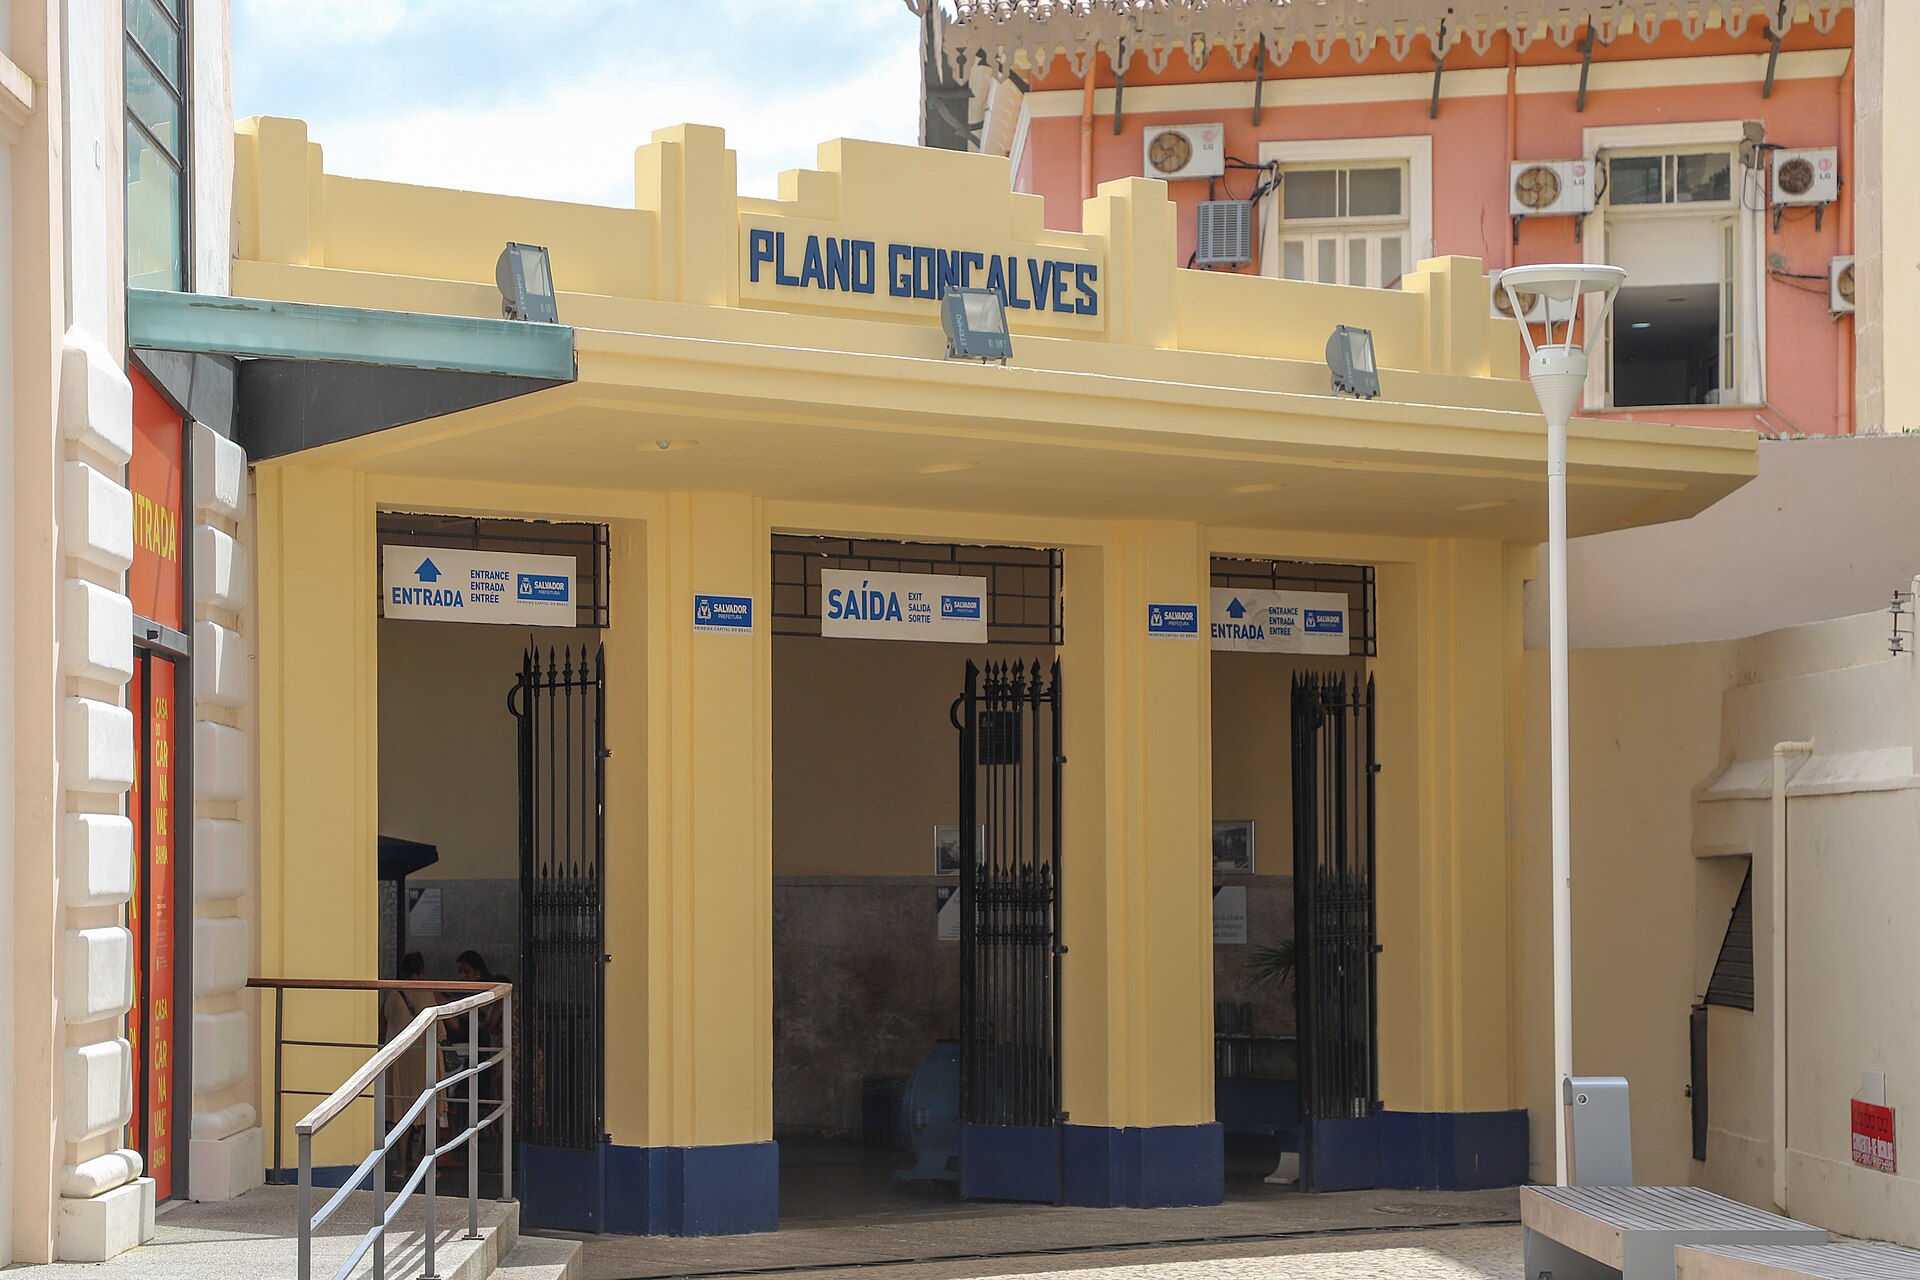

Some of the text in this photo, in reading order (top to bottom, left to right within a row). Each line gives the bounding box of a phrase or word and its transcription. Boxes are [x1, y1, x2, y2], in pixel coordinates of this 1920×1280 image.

[750, 229, 875, 295] PLANO
[131, 490, 177, 563] NTRADA
[470, 569, 510, 581] ENTRANCE
[470, 581, 505, 592] ENTRADA
[534, 580, 565, 591] SALVADOR
[392, 586, 464, 608] ENTRADA
[470, 591, 500, 604] ENTRÉE
[827, 580, 903, 622] SAÍDA
[908, 592, 923, 601] EXIT
[713, 603, 748, 615] SALVADOR
[908, 603, 931, 613] SALIDA
[953, 600, 977, 609] SALVADOR
[1268, 606, 1298, 616] ENTRANCE
[908, 614, 931, 624] SORTIE
[1164, 611, 1194, 621] SALVADOR
[1269, 616, 1296, 626] ENTRADA
[1316, 614, 1340, 624] SALVADOR
[1210, 622, 1265, 640] ENTRADA
[155, 697, 168, 720] CASA
[155, 739, 168, 768] CAR
[159, 774, 168, 802] NA
[155, 845, 168, 865] BAHIA
[155, 998, 168, 1022] CASA
[154, 1040, 168, 1071] CAR
[158, 1074, 167, 1104] NA
[153, 1149, 166, 1169] BAHIA
